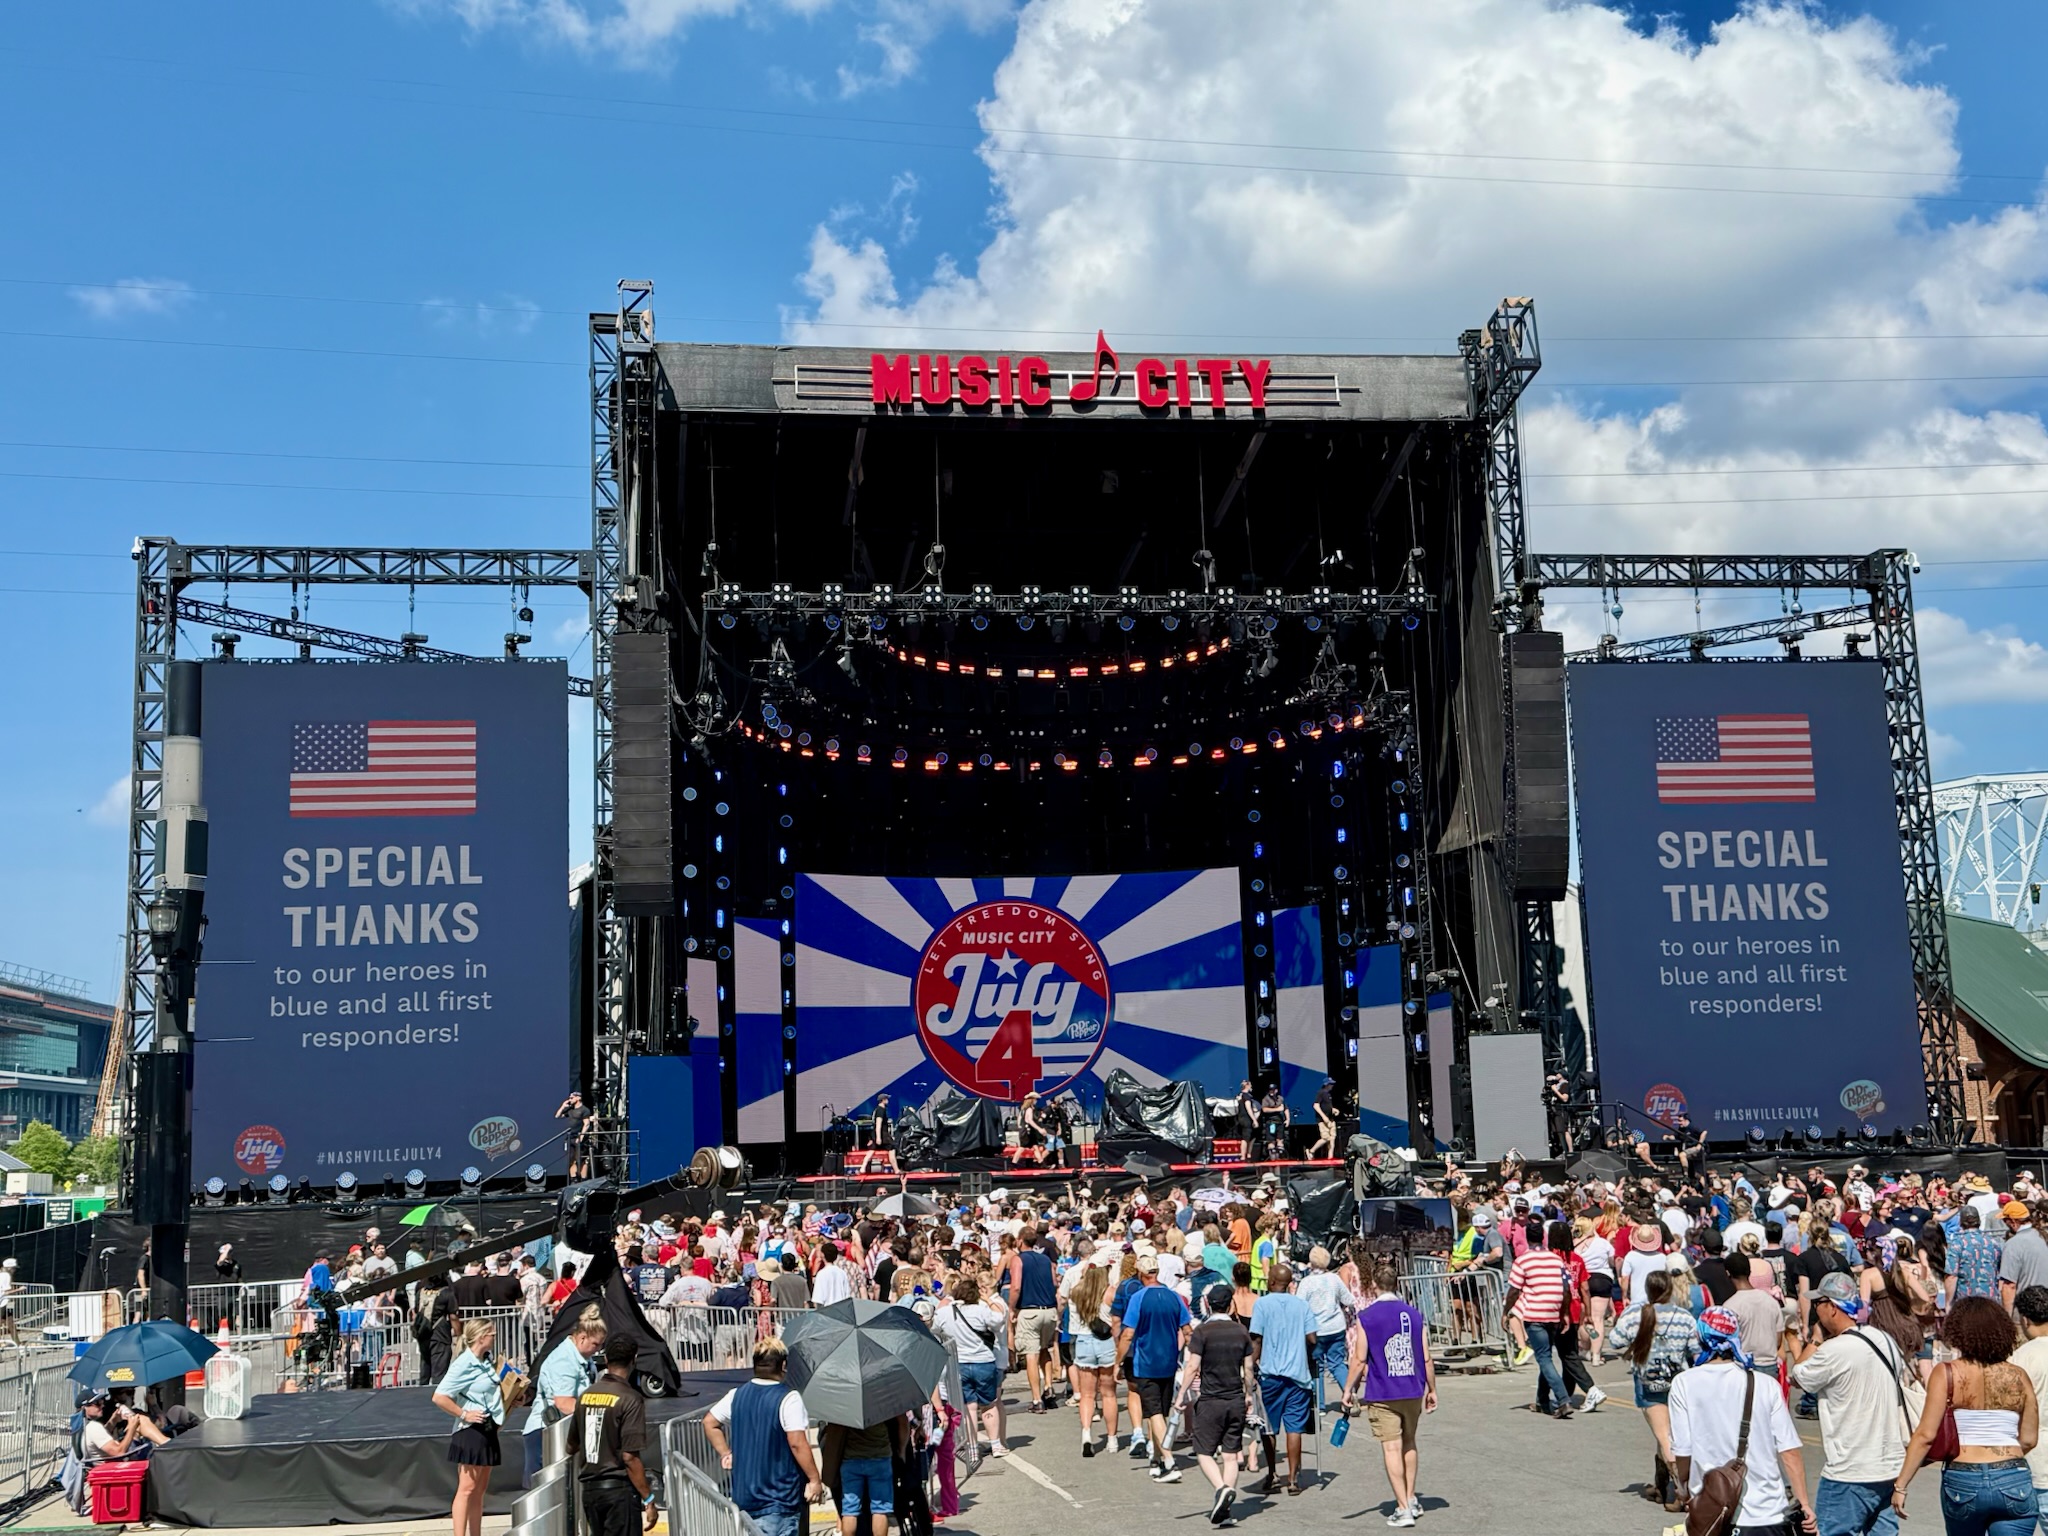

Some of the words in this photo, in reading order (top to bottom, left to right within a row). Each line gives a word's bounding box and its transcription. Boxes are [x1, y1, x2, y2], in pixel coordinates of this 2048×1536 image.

[870, 353, 1051, 407] MUSIC
[1135, 358, 1271, 409] CITY
[1657, 830, 1828, 869] SPECIAL
[282, 845, 483, 889] SPECIAL
[1662, 882, 1829, 922] THANKS
[283, 901, 480, 947] THANKS
[924, 939, 947, 974] LET
[955, 906, 1057, 933] FREEDOM
[1069, 932, 1103, 981] SING
[961, 932, 1014, 945] MUSIC
[1018, 931, 1057, 944] CITY
[1660, 939, 1684, 956] to
[1692, 941, 1729, 956] our
[1737, 936, 1812, 955] heroes
[1820, 934, 1840, 953] in
[273, 966, 301, 985] to
[312, 967, 356, 985] our
[366, 961, 455, 983] heroes
[465, 958, 487, 980] in
[1660, 966, 1709, 986] blue
[1717, 964, 1758, 985] and
[1767, 964, 1795, 984] all
[1800, 963, 1847, 983] first
[270, 995, 328, 1017] blue
[338, 992, 386, 1016] and
[397, 991, 431, 1014] all
[437, 990, 493, 1012] first
[925, 952, 1082, 1039] July
[1690, 993, 1822, 1018] responders!
[302, 1023, 459, 1052] responders!
[974, 1009, 1044, 1101] 4
[1646, 1095, 1682, 1116] July
[1714, 1107, 1819, 1121] #NASHVILLEJULY4
[487, 1121, 503, 1135] Dr
[236, 1137, 279, 1160] July
[317, 1146, 441, 1164] #NASHVILLEJULY4
[580, 1392, 620, 1408] SECURITY
